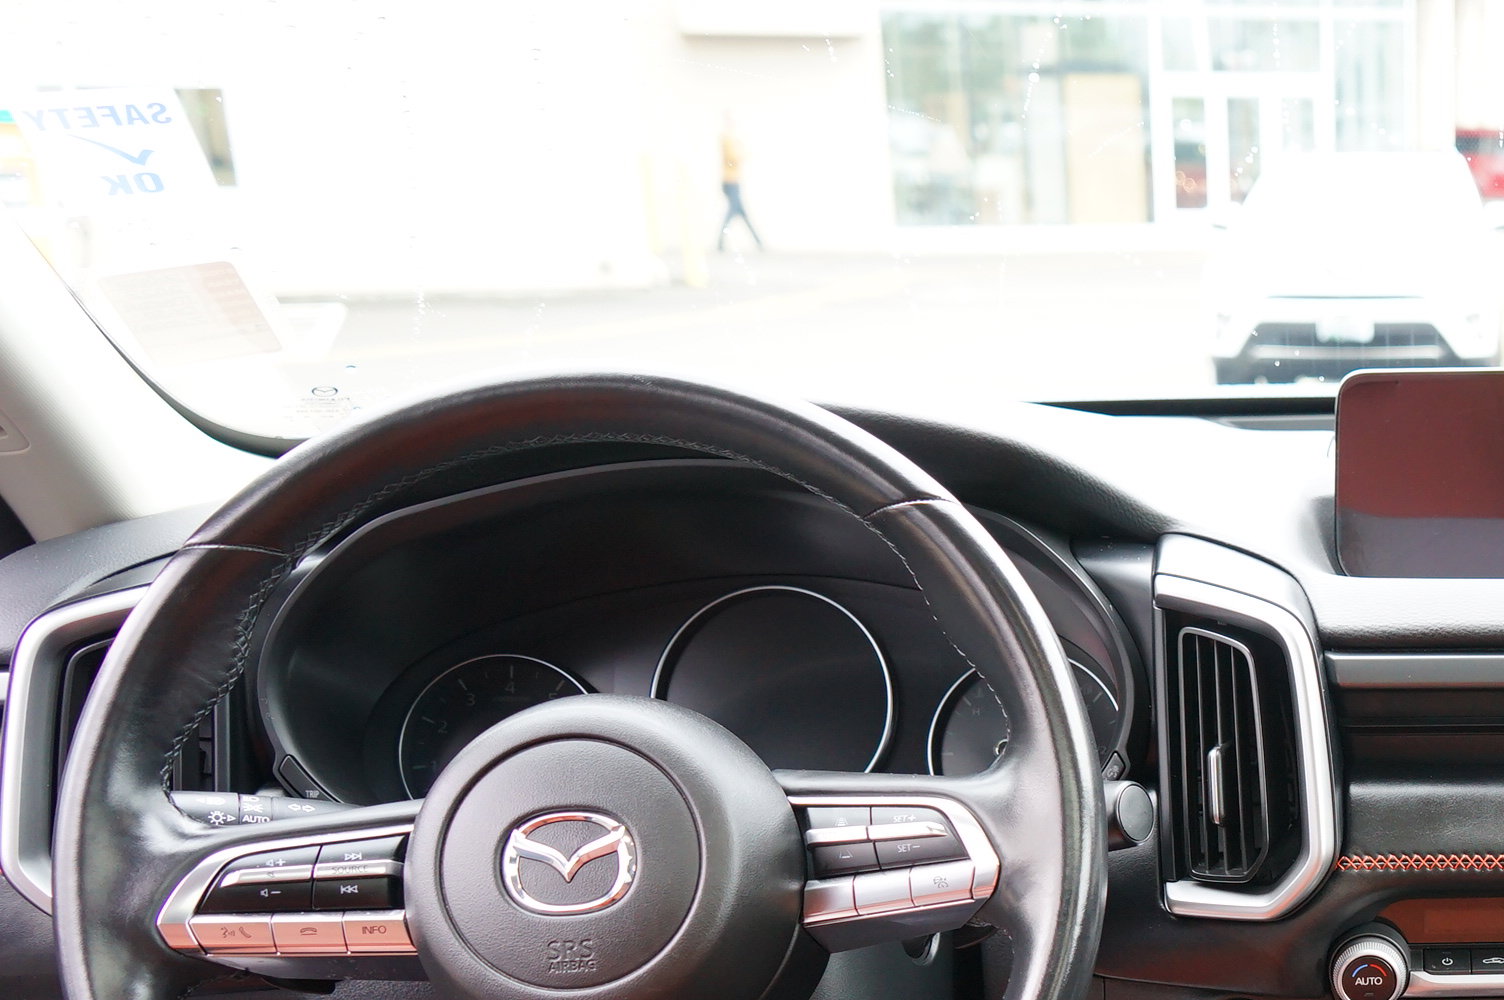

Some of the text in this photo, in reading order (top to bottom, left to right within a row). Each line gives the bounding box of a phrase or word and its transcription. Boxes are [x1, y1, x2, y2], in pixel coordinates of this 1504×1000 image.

[242, 814, 270, 824] AUTO
[331, 865, 369, 876] SOURCE
[361, 925, 387, 935] INFO
[547, 939, 594, 961] SRS
[548, 959, 597, 973] AIRBAG
[1355, 976, 1383, 986] AUTO
